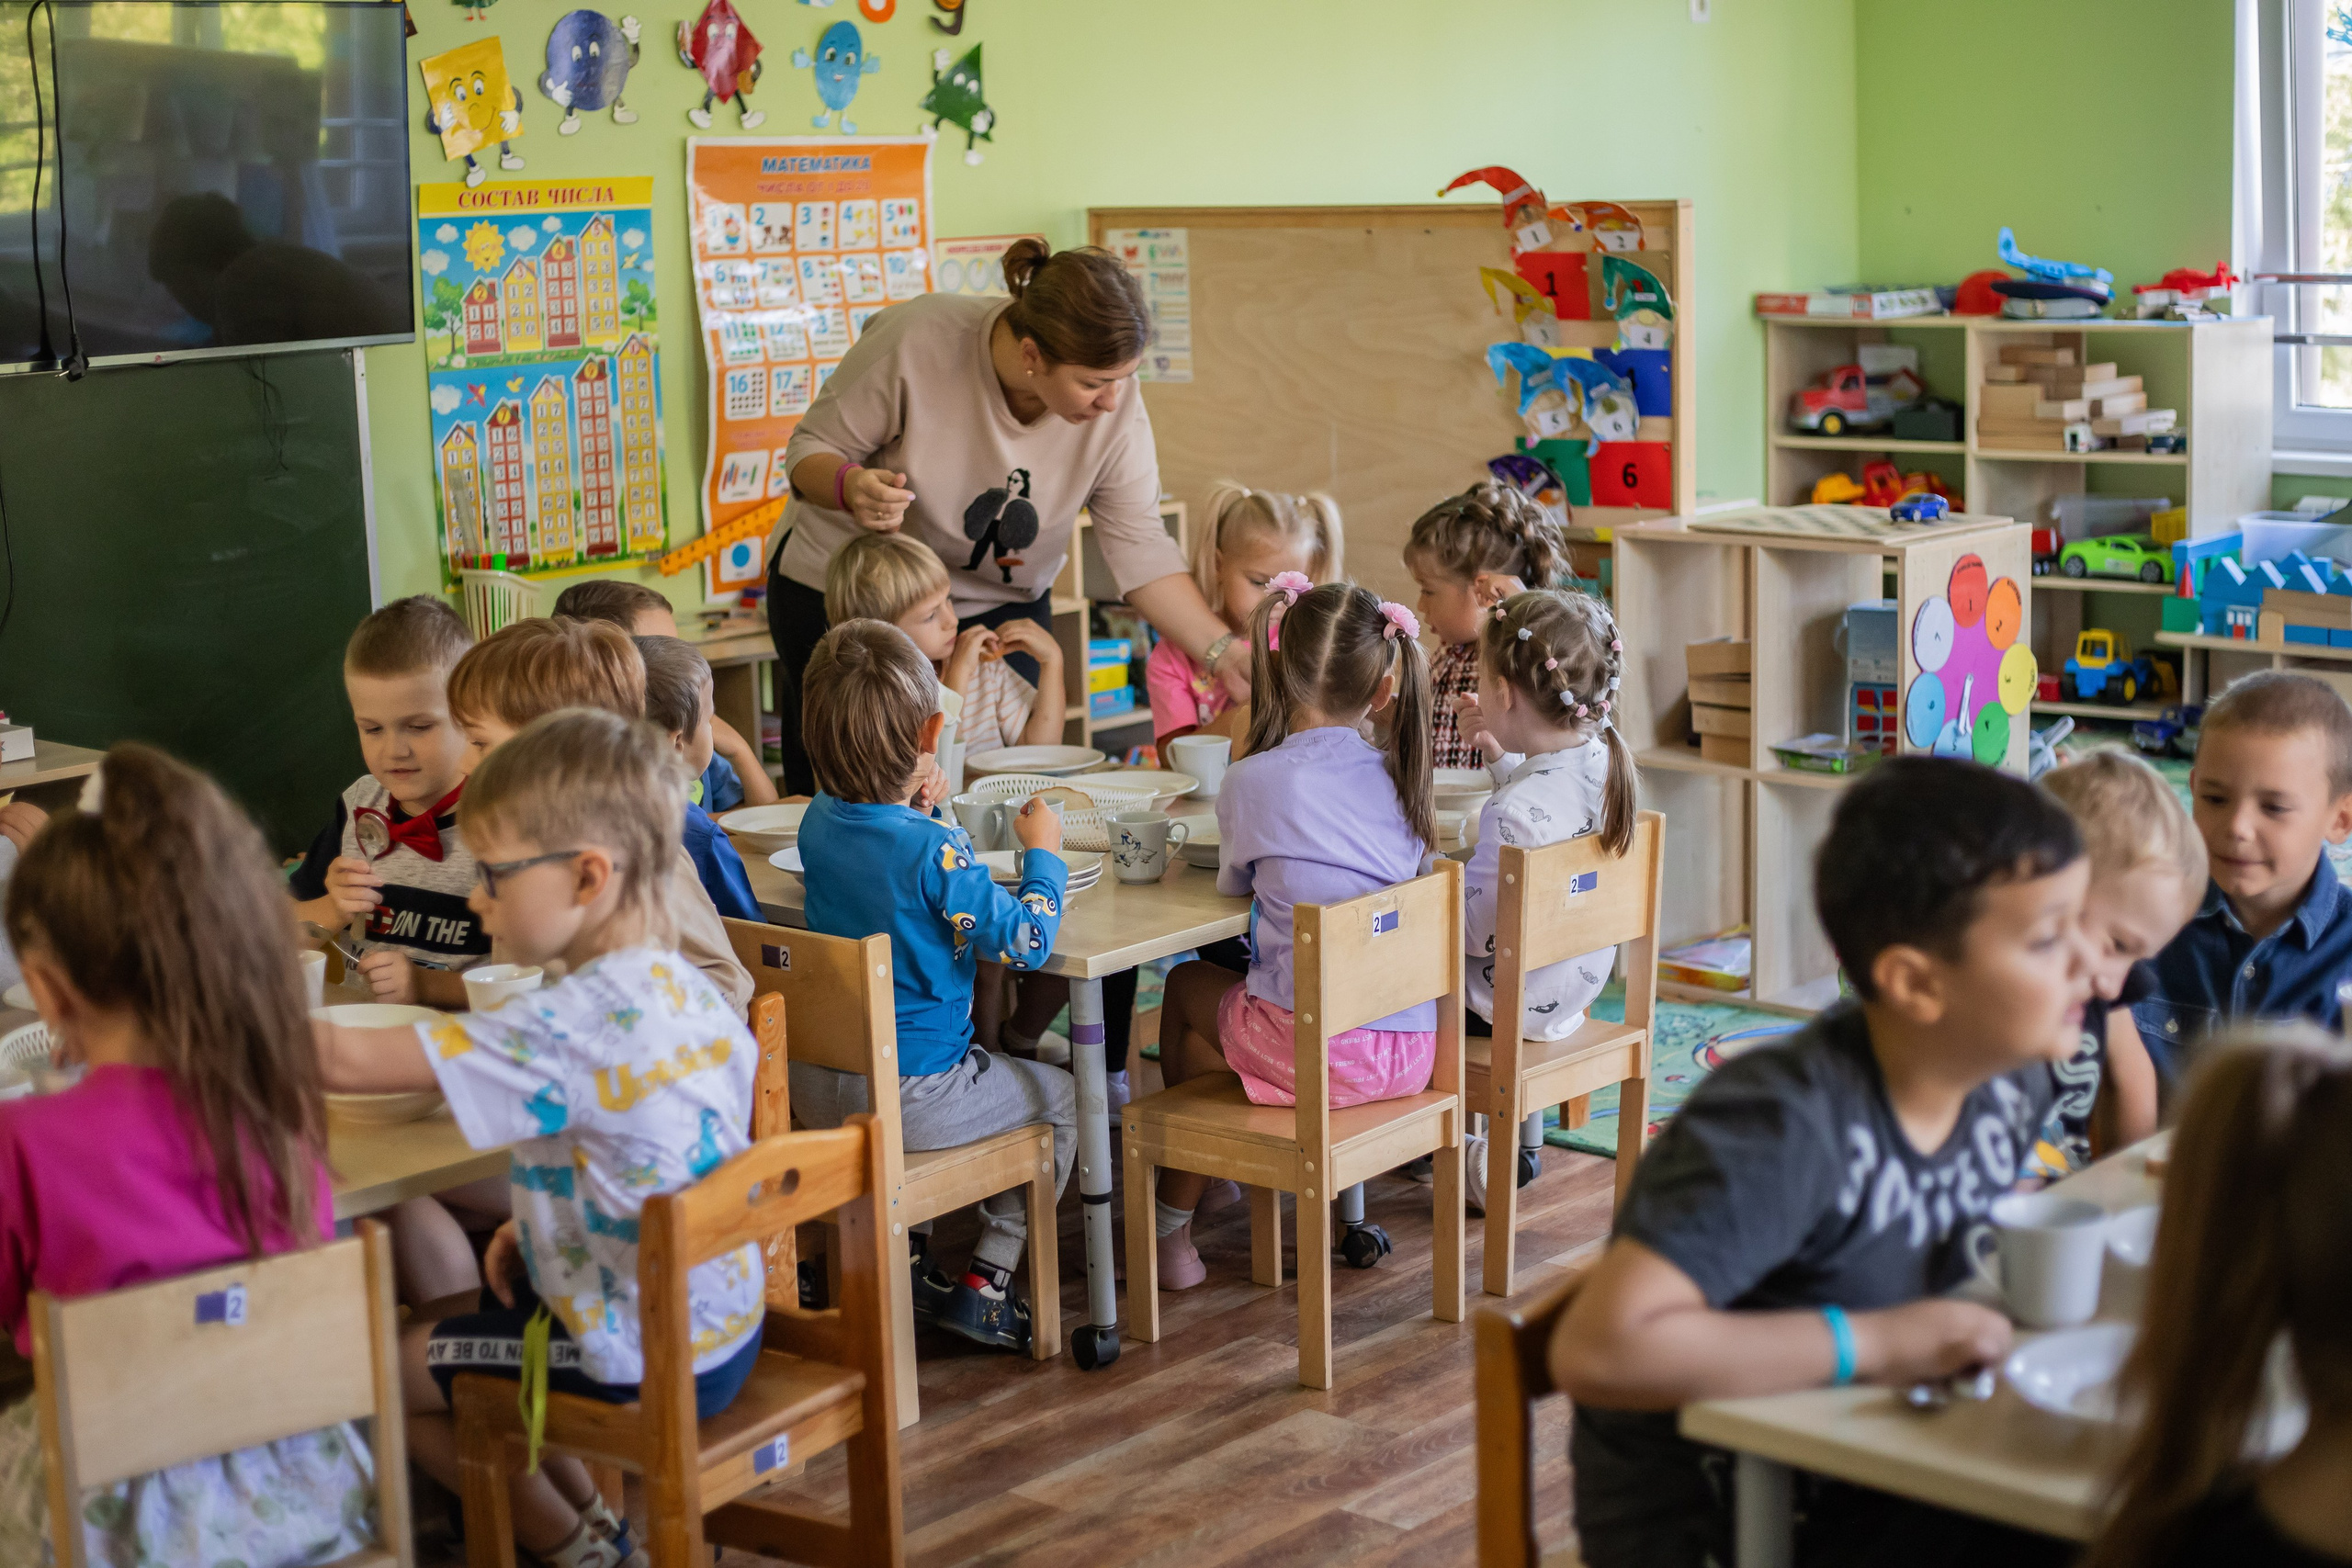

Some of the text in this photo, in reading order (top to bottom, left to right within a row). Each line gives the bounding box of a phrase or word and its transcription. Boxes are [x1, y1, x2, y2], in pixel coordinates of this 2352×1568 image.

[761, 155, 871, 174] МАТЕМАТИКА
[458, 186, 615, 209] СОСТАВ ЧИСЛА
[754, 208, 765, 226] 2
[801, 207, 811, 225] 3
[842, 205, 854, 221] 4
[886, 204, 895, 221] 5
[715, 256, 906, 283] 6 7 8 9 10
[1545, 271, 1558, 297] 1
[729, 375, 748, 393] 16
[775, 371, 793, 389] 17
[1623, 463, 1637, 489] 6
[1571, 879, 1577, 894] 2
[390, 909, 470, 945] ON THE
[1374, 917, 1380, 932] 2
[781, 951, 789, 967] 2
[1340, 1037, 1361, 1045] FRIEND
[1335, 1059, 1355, 1067] FRIEND
[229, 1296, 242, 1318] 2
[453, 1341, 473, 1360] BE
[480, 1341, 499, 1359] TO
[777, 1442, 786, 1462] 2
